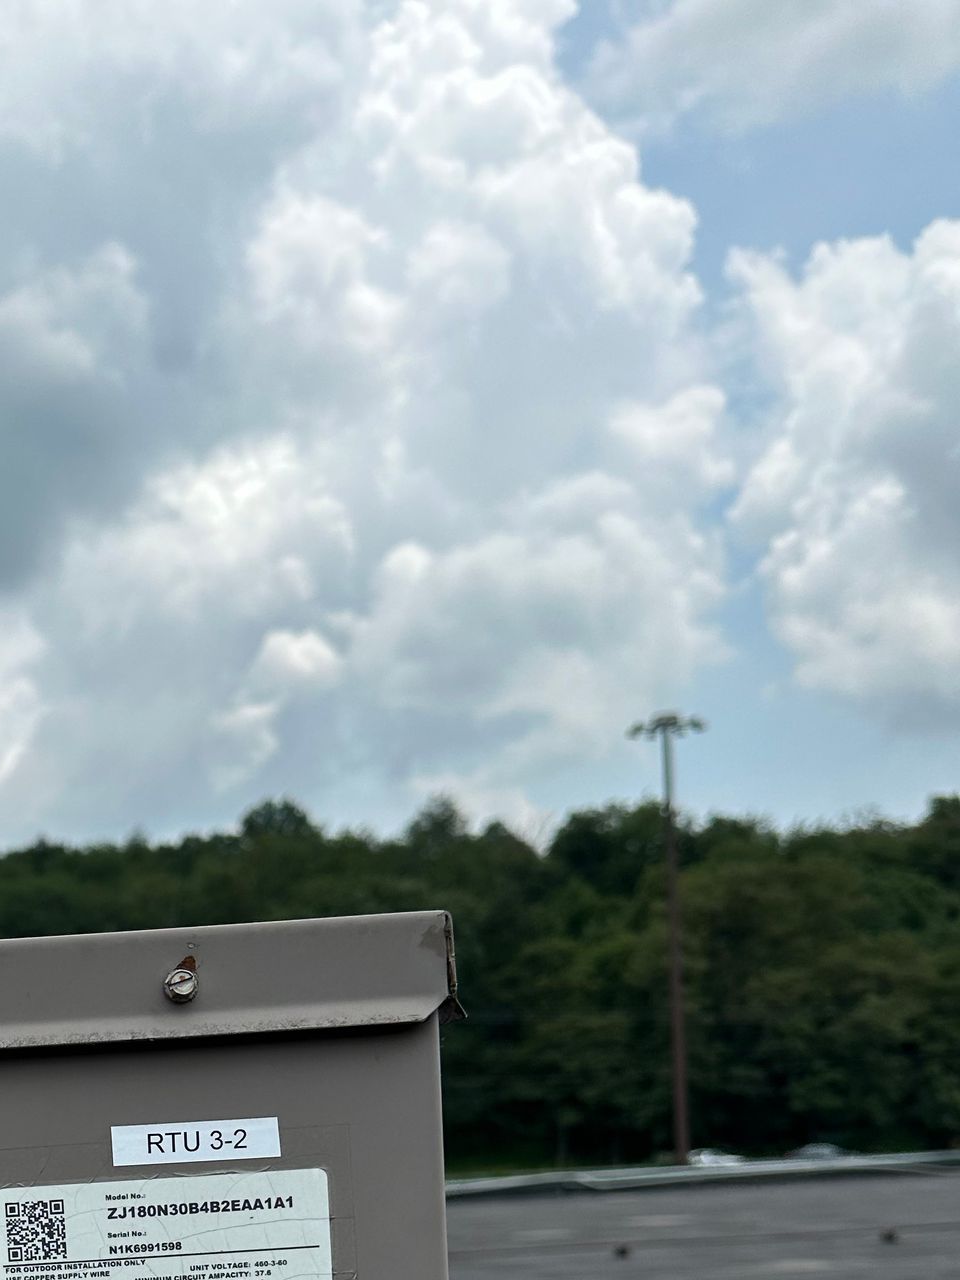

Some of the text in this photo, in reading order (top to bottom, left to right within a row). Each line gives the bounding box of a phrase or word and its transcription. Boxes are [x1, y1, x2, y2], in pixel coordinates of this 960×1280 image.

[147, 1129, 248, 1154] RTU 3-2
[105, 1193, 129, 1201] Model
[107, 1195, 293, 1220] ZJ180N30B4B2EAA1A1
[107, 1231, 130, 1239] Serial
[109, 1241, 182, 1255] N1K6991598
[5, 1259, 146, 1274] FOR OUTDOOR INSTALLATION ONLY
[189, 1264, 210, 1272] UNIT
